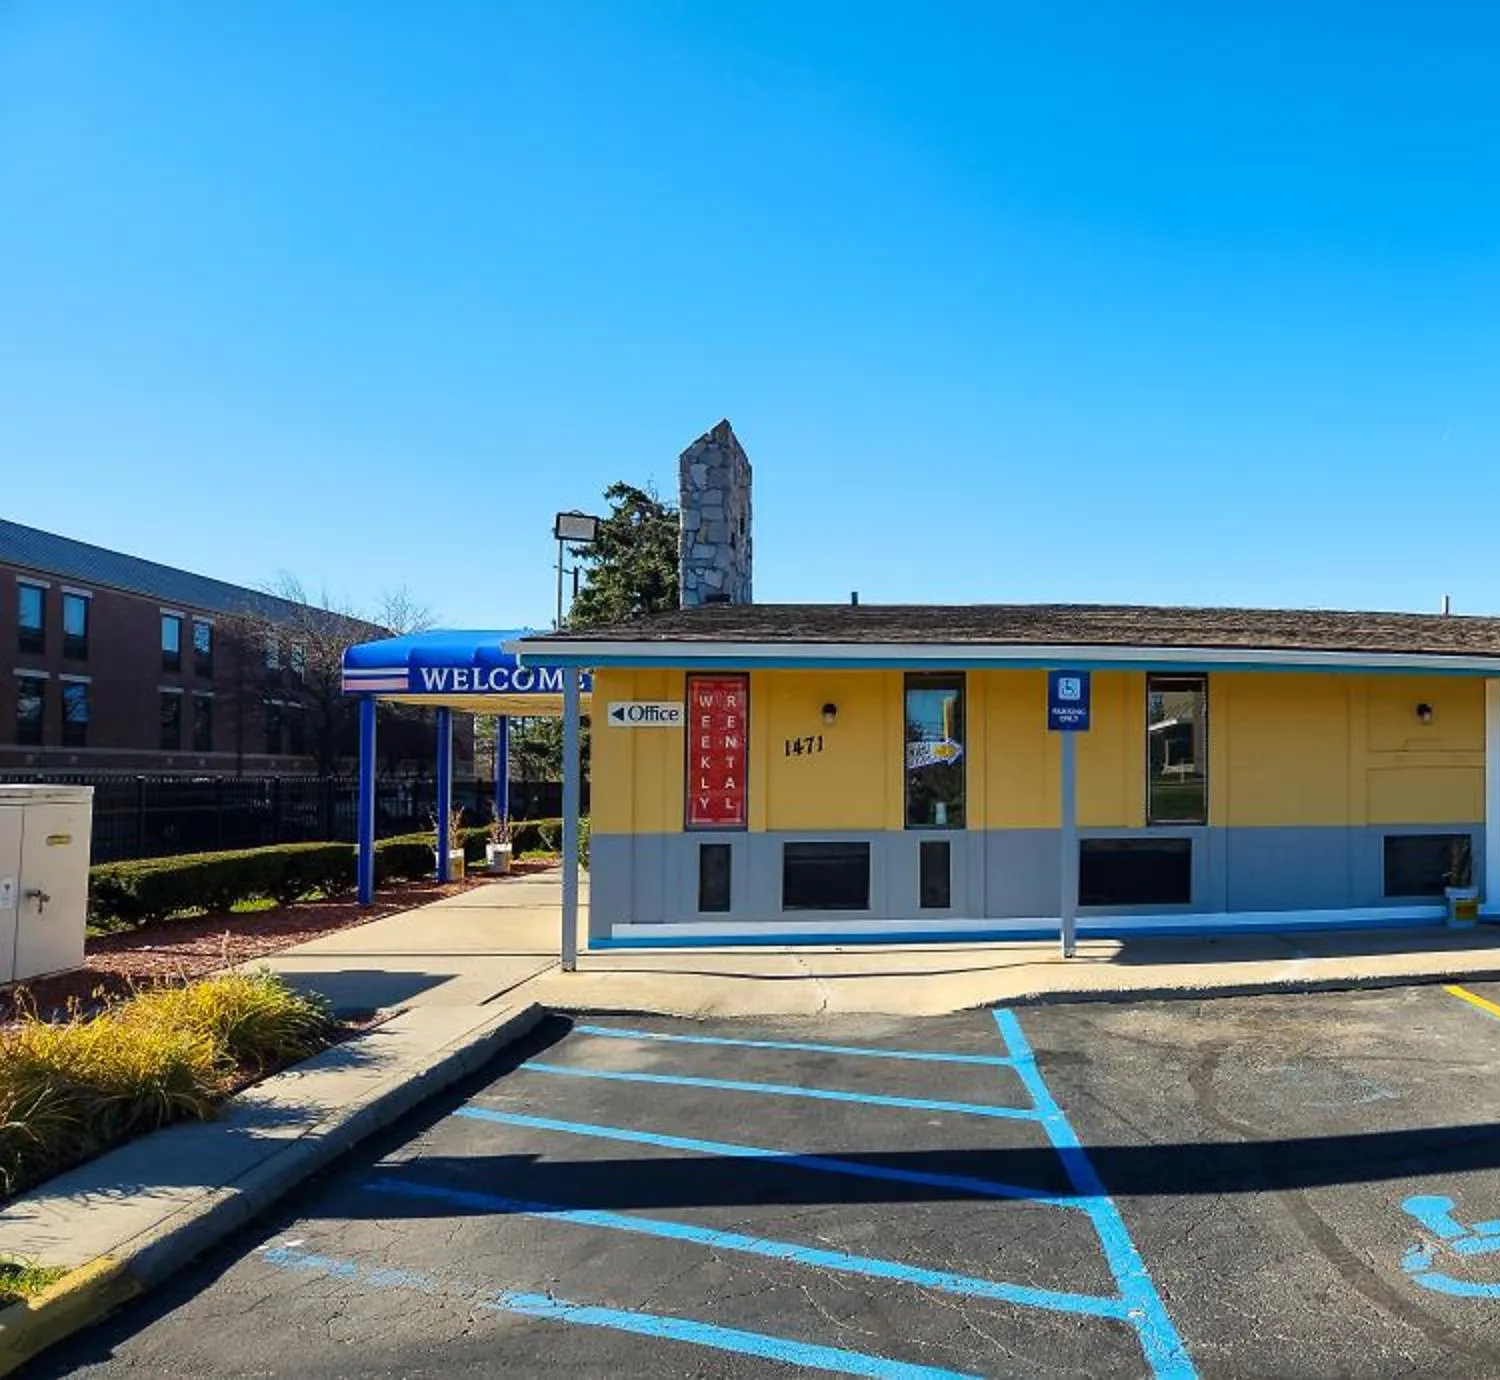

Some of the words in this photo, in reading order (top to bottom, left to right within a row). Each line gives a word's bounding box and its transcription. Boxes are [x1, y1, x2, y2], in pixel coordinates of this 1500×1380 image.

[627, 705, 679, 721] Office
[784, 735, 823, 756] 1471
[699, 695, 713, 809] WEEKLY
[725, 695, 737, 809] RENTAL
